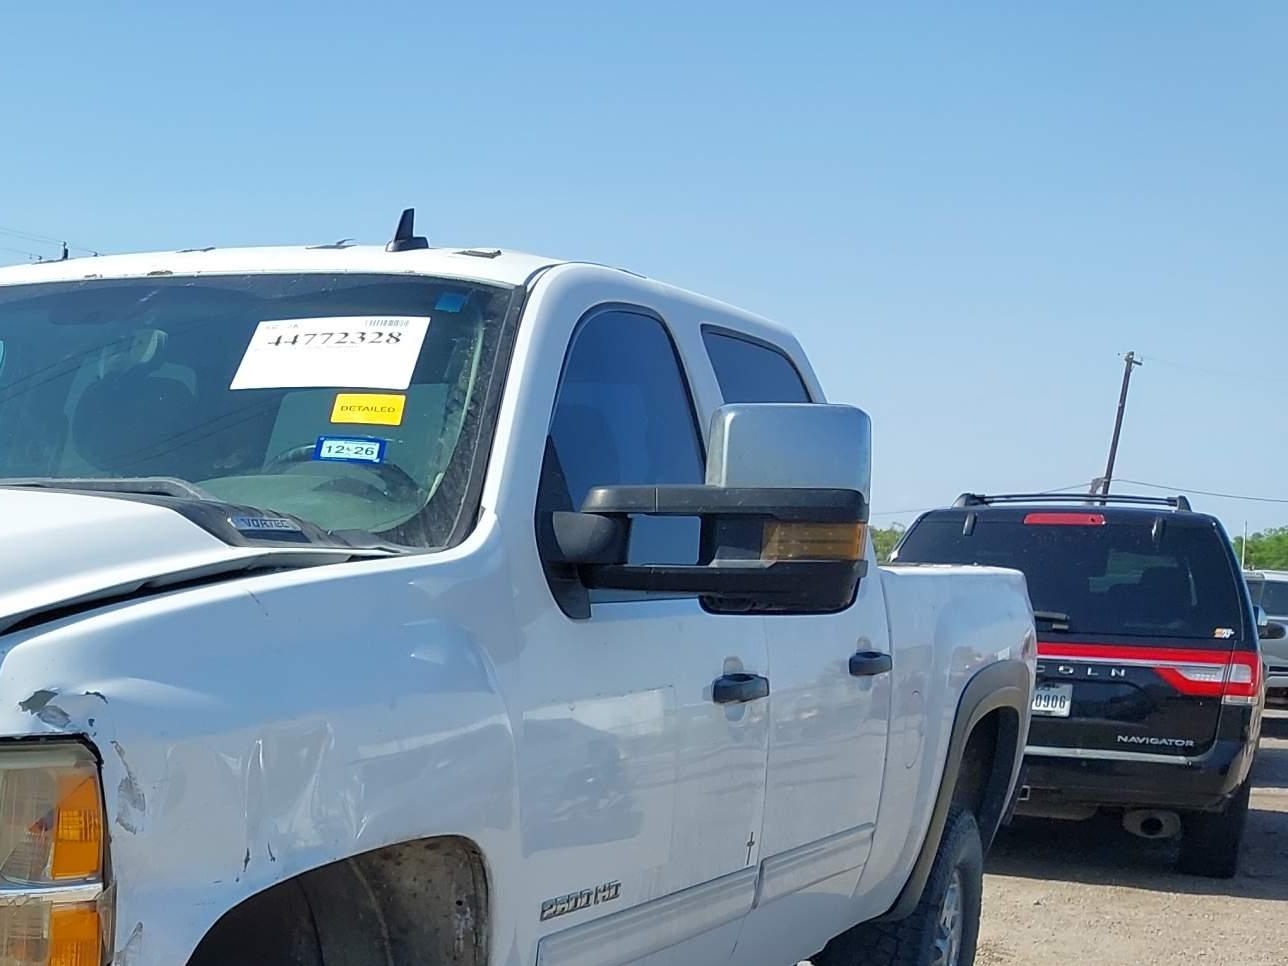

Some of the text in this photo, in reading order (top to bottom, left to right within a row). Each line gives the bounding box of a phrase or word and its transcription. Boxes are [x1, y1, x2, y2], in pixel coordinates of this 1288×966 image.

[267, 330, 403, 347] 44772328
[339, 404, 396, 414] DETAILED
[325, 445, 375, 456] 12 26
[239, 518, 290, 528] VORTEC
[1116, 734, 1195, 749] NAVIGATOR
